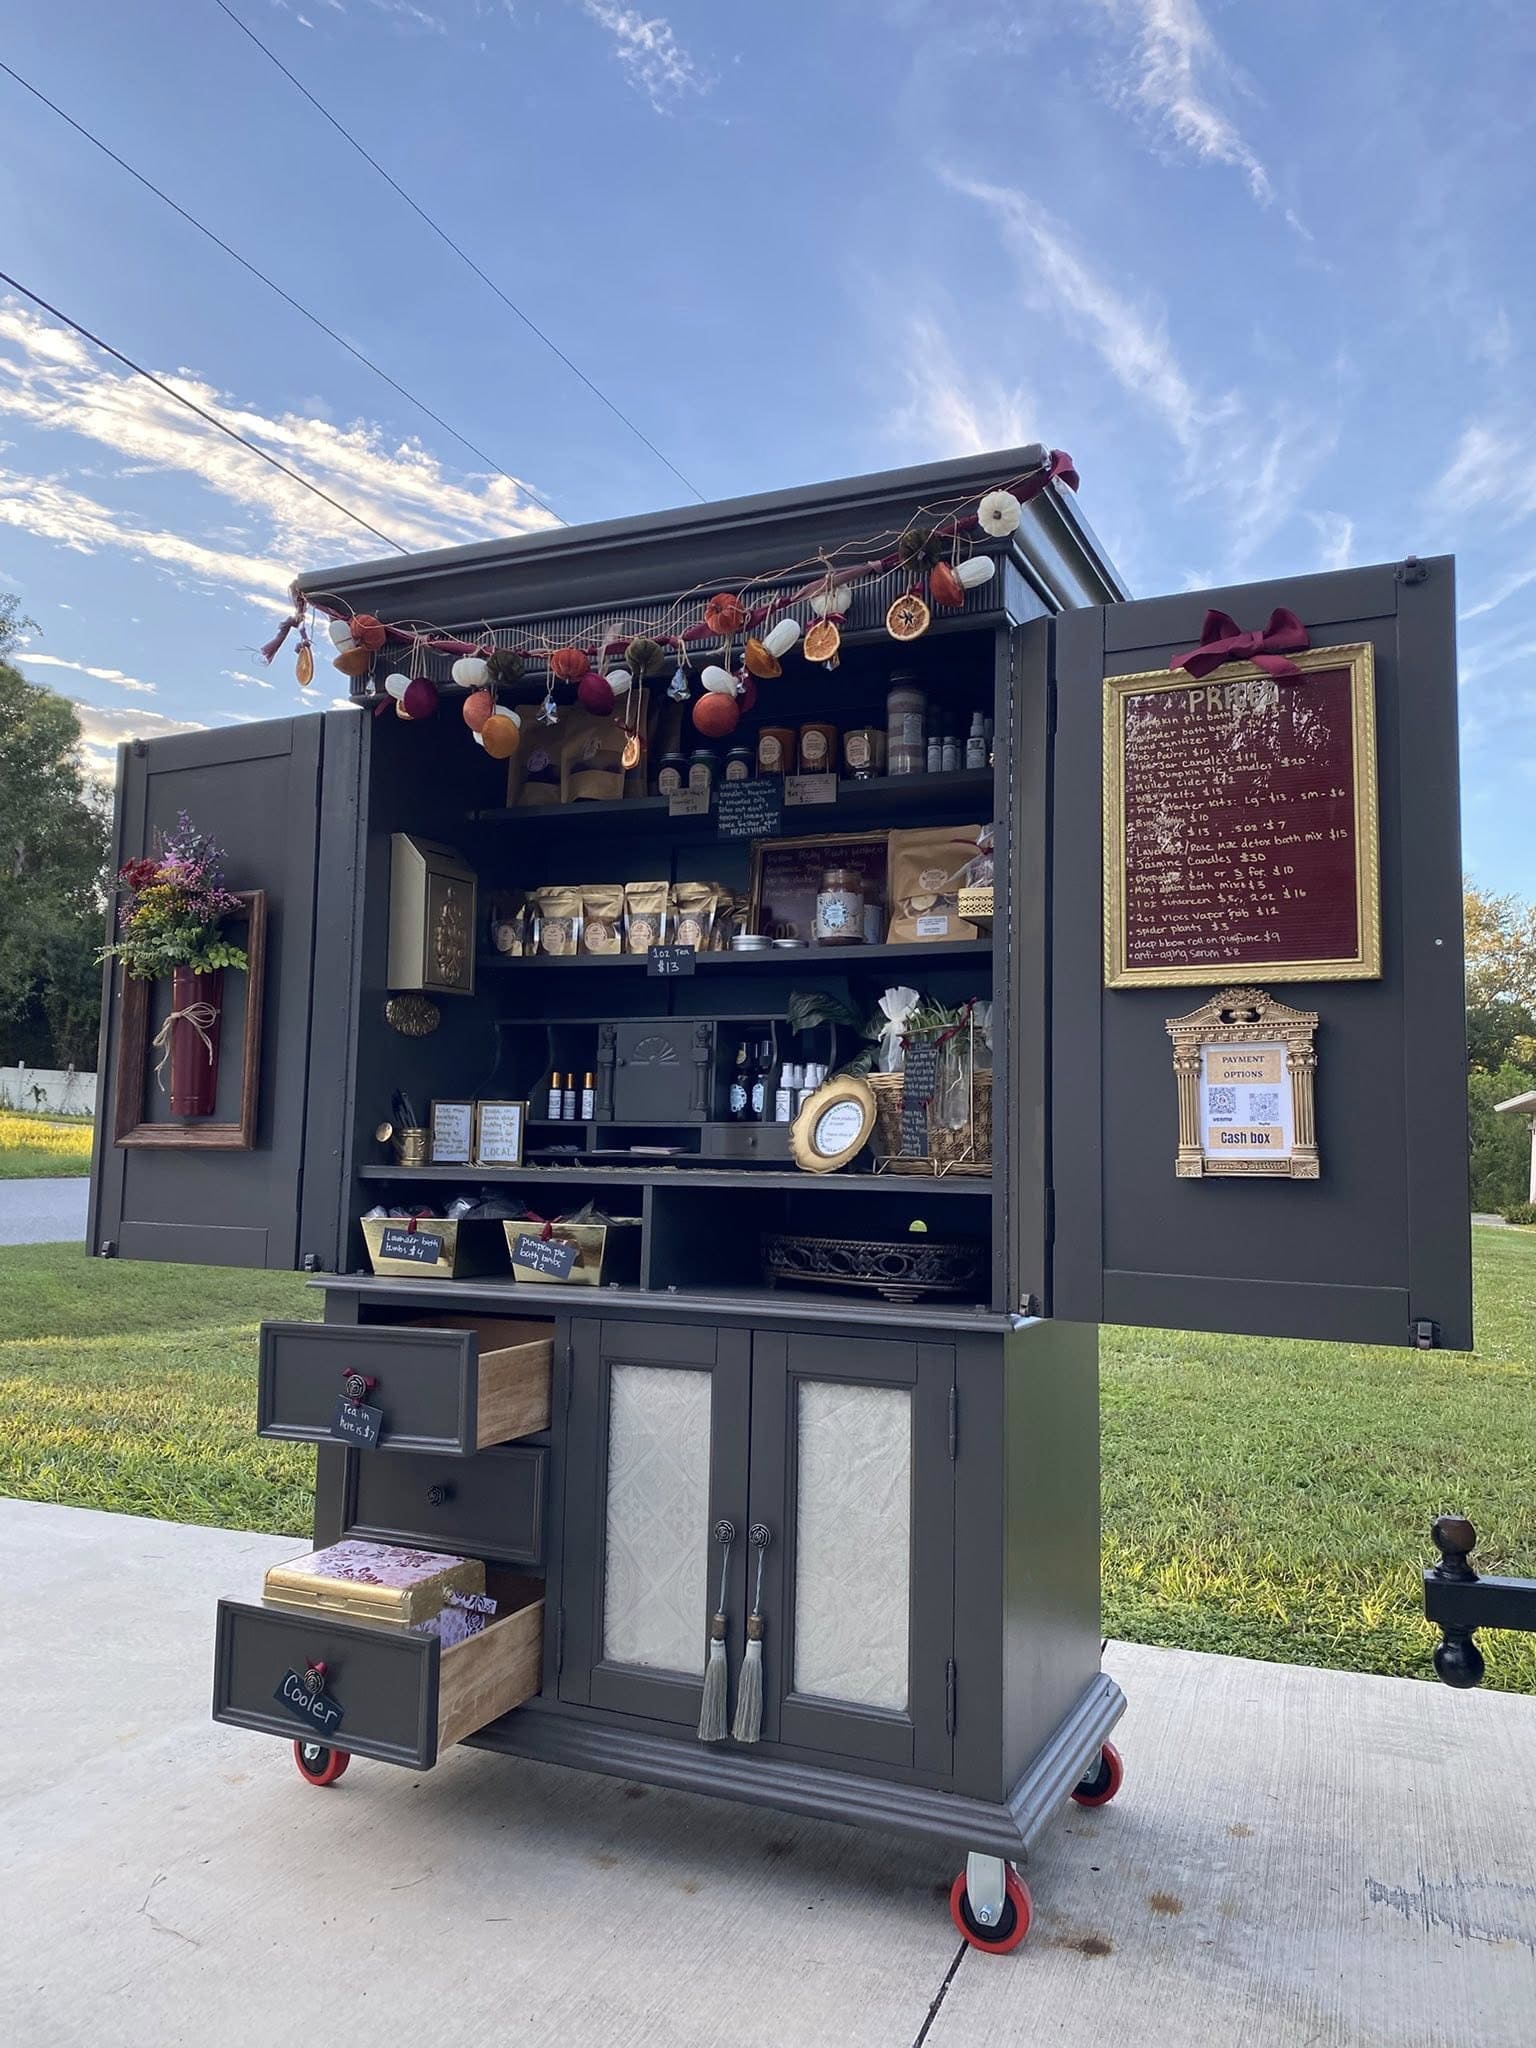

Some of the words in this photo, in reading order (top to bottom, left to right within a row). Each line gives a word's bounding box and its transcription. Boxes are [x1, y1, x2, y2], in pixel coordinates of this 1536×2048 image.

[1134, 949, 1188, 962] anti-aging
[1189, 949, 1220, 959] serum
[657, 959, 680, 973] $13
[1222, 1055, 1265, 1064] PAYMENT
[1223, 1070, 1265, 1079] OPTIONS
[1220, 1131, 1247, 1144] Cash
[1251, 1132, 1271, 1144] box
[421, 1236, 439, 1248] bath
[519, 1247, 540, 1261] bath
[343, 1403, 357, 1417] Tea
[361, 1411, 370, 1421] in
[339, 1415, 355, 1432] here
[362, 1424, 376, 1441] $7
[283, 1674, 338, 1724] Cooler
